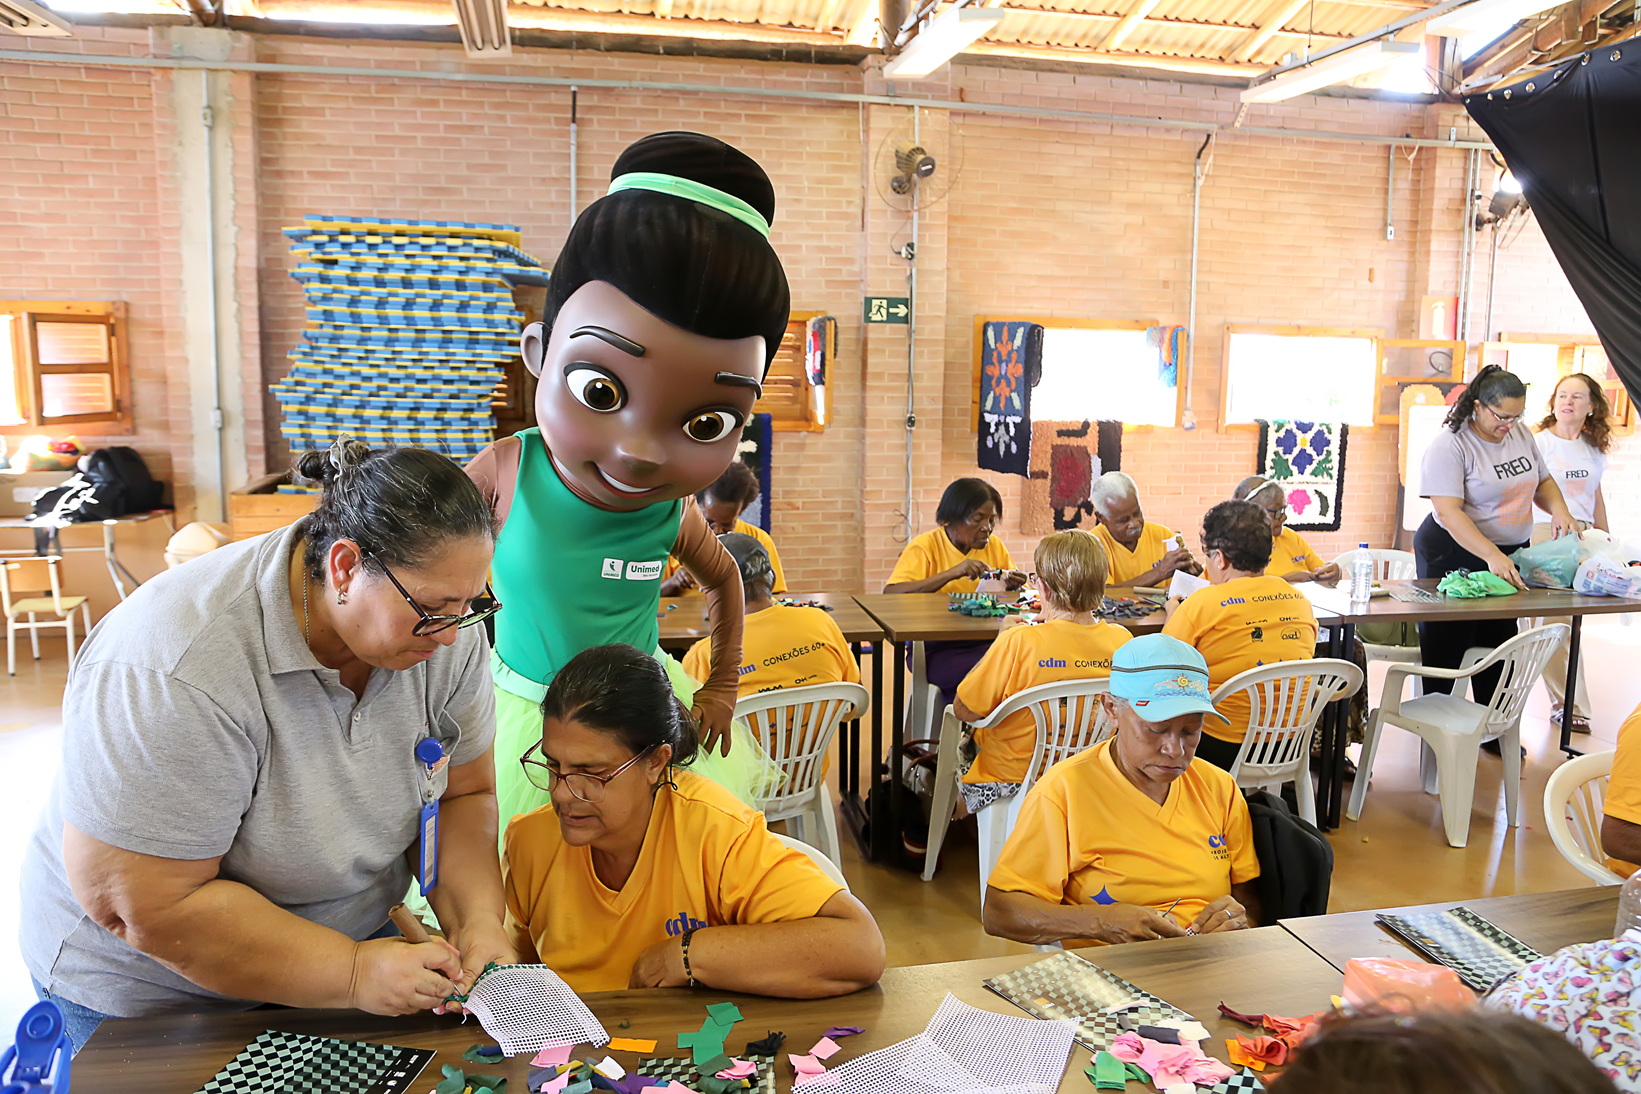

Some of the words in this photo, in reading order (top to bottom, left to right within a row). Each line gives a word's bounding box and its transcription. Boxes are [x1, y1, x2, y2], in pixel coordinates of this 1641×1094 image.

[1493, 456, 1532, 480] FRED
[1565, 469, 1589, 479] FRED
[631, 565, 660, 573] Unimed
[1220, 597, 1246, 607] cdm
[1252, 592, 1294, 602] CONEXÕES
[762, 645, 810, 667] CONEXÕES
[811, 642, 826, 651] 60+
[1038, 657, 1067, 668] cdm
[1074, 658, 1113, 668] CONEXÕ
